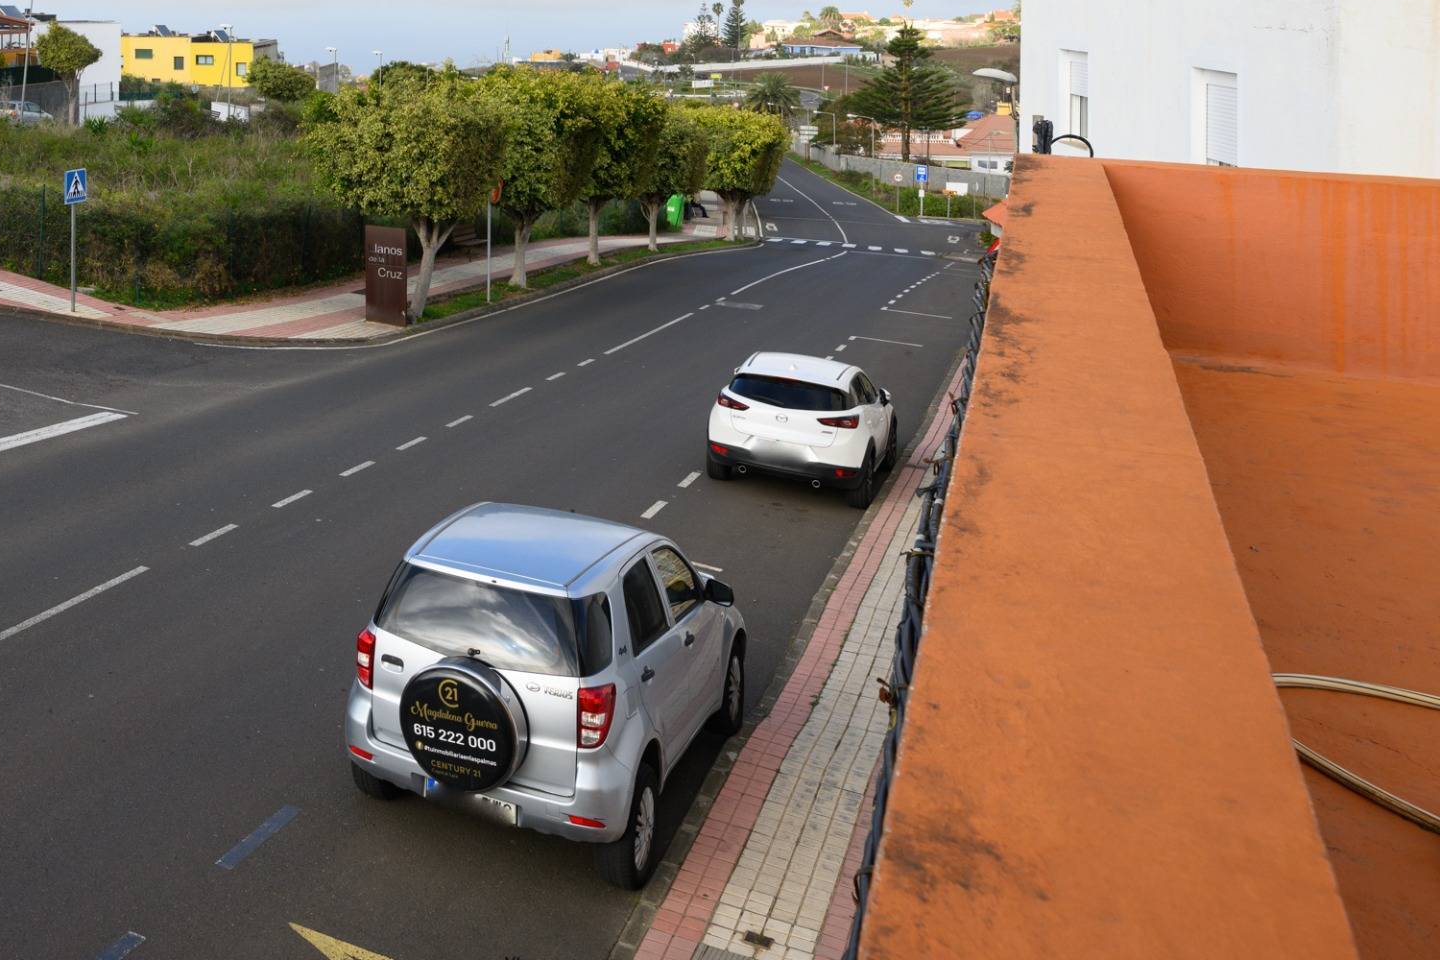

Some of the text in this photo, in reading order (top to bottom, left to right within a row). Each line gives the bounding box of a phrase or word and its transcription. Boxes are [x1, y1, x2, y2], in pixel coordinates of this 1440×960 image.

[377, 267, 403, 280] Cruz
[410, 701, 498, 732] Magdalena Guerra
[413, 723, 496, 752] 615 222 000
[431, 759, 471, 774] CENTURY
[473, 769, 481, 778] 21
